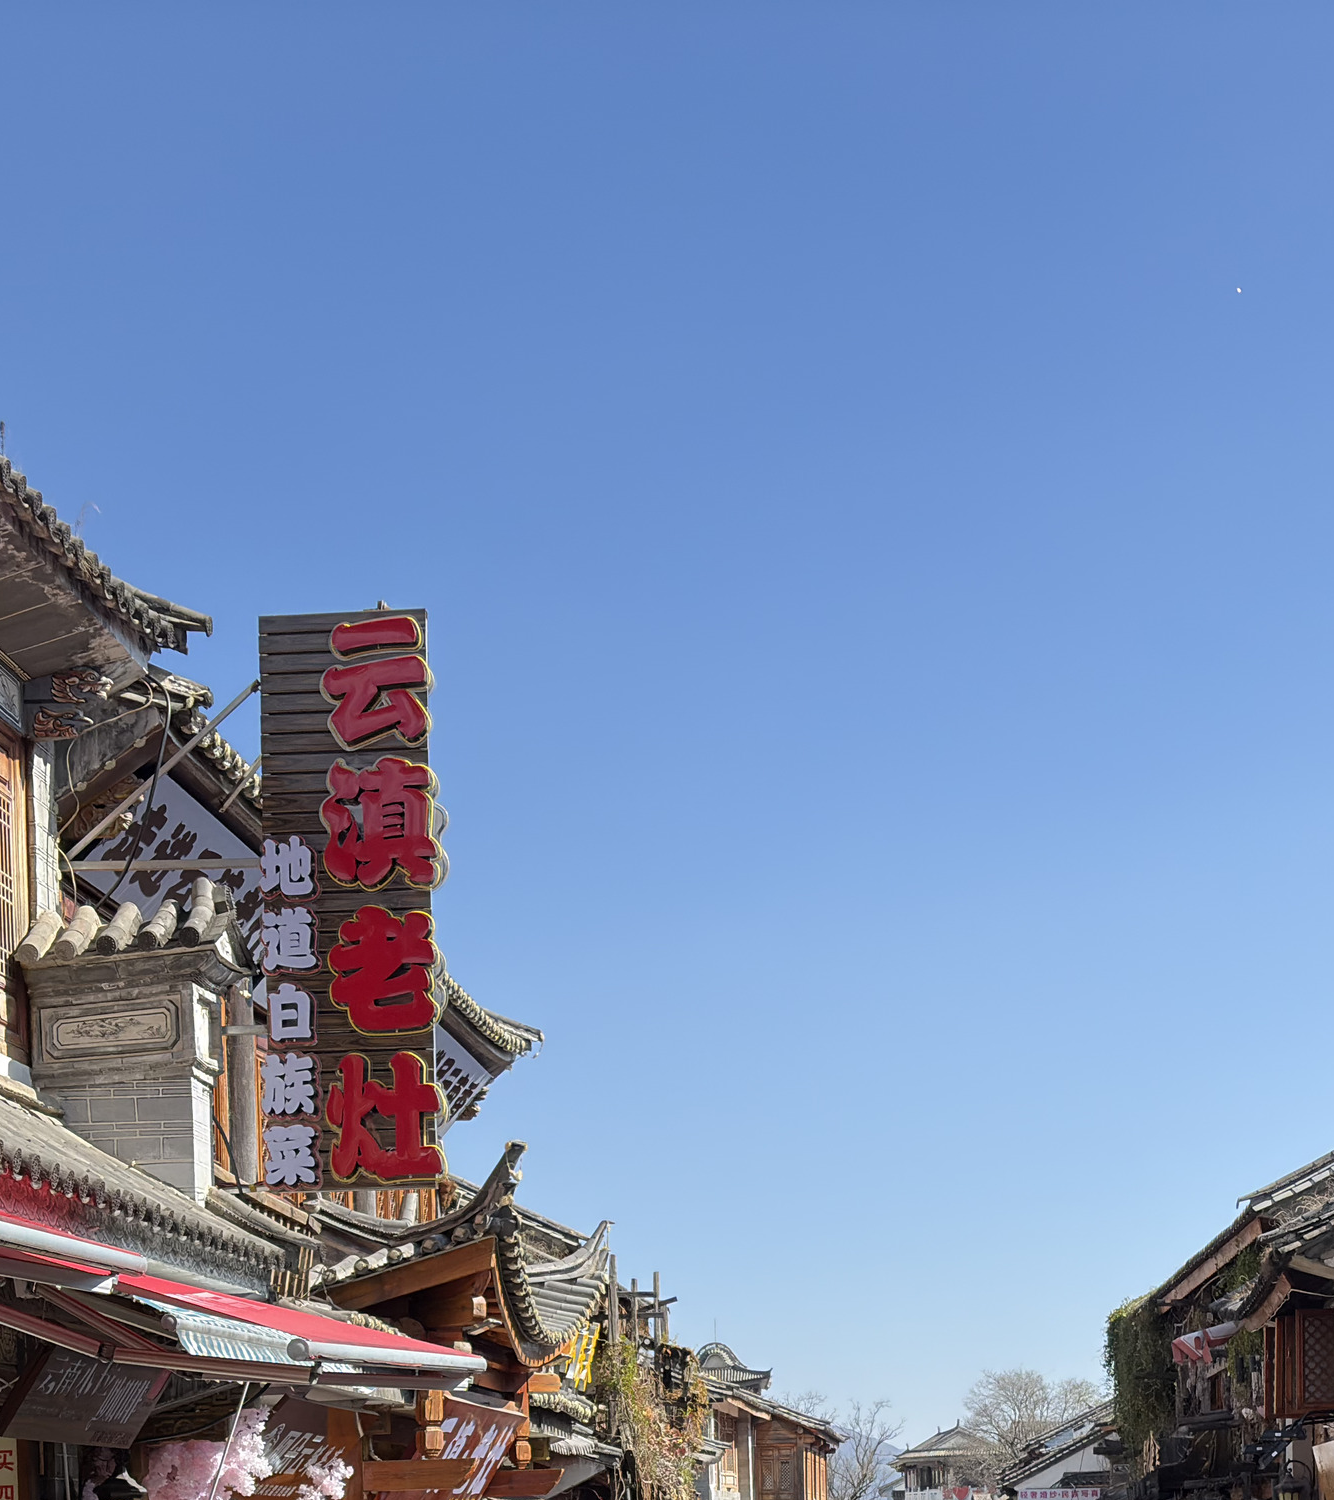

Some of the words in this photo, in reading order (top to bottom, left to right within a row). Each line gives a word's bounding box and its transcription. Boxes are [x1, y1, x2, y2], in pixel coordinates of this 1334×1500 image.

[260, 835, 322, 1188] 地道白族菜
[319, 615, 447, 1186] 云滇老灶
